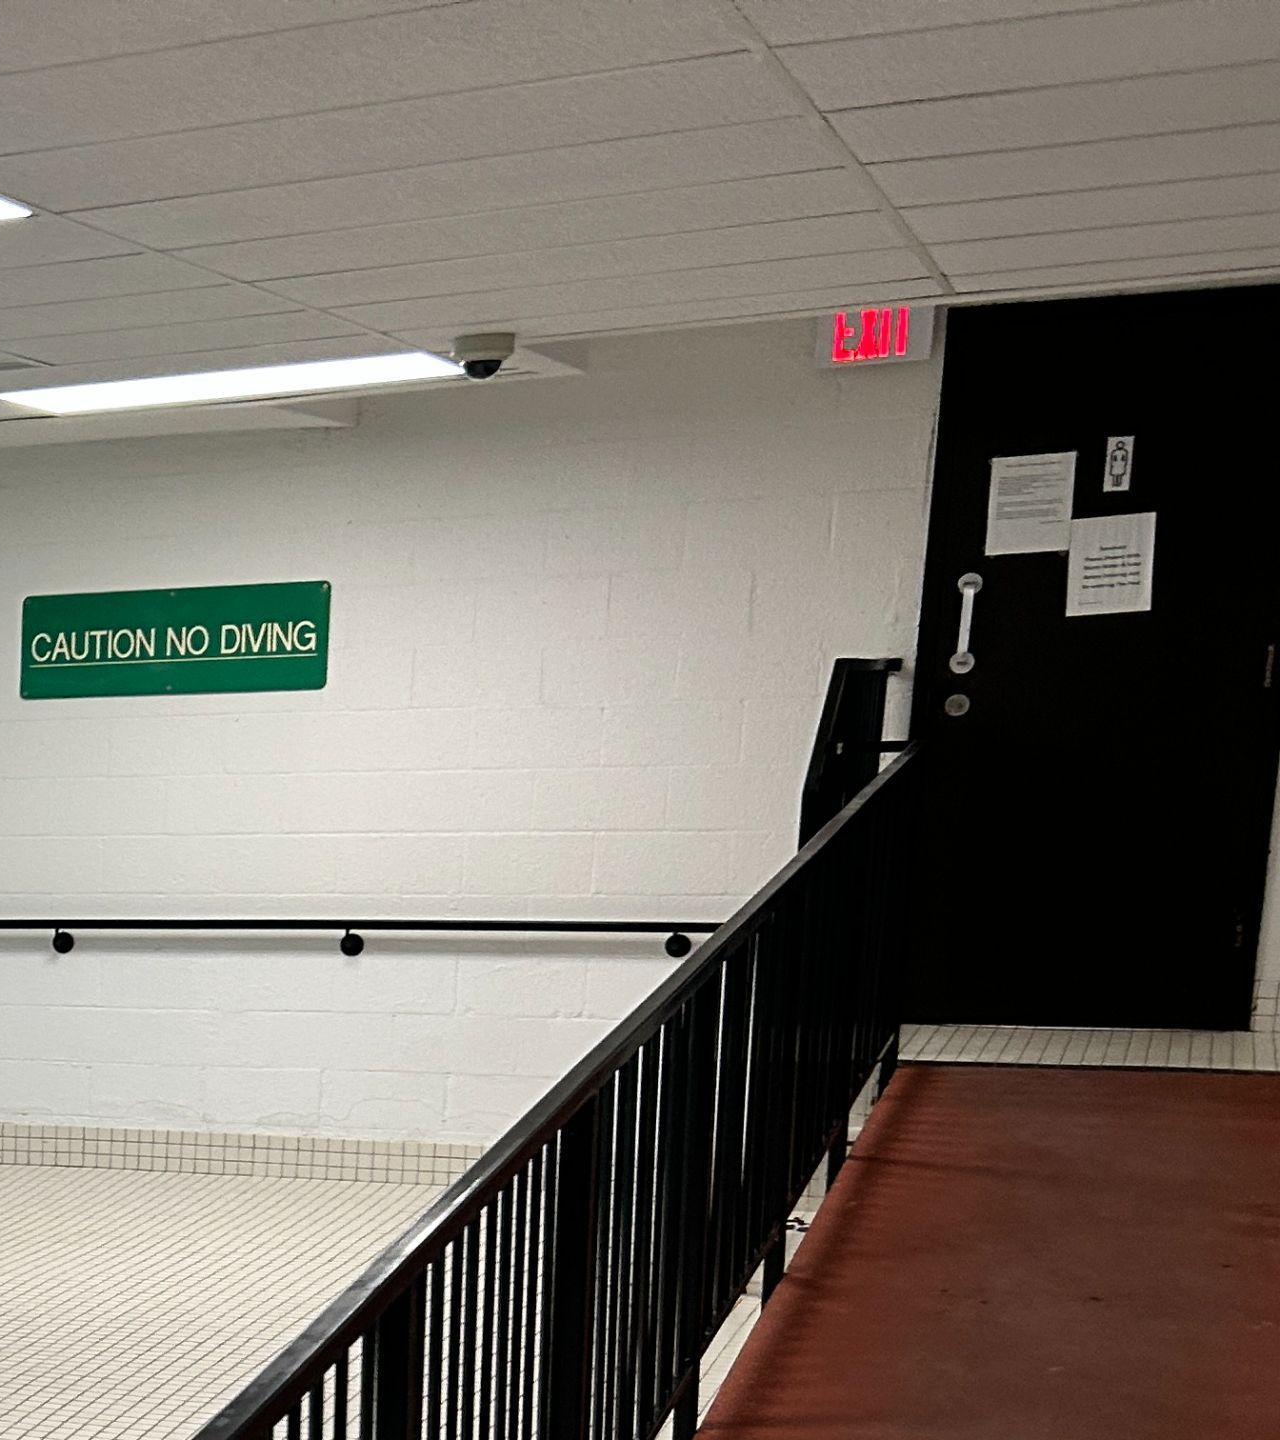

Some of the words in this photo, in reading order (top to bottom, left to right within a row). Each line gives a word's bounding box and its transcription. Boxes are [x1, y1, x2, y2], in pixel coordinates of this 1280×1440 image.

[831, 305, 910, 362] EXIT
[31, 628, 156, 662] CAUTION
[166, 626, 209, 656] NO
[220, 621, 317, 654] DIVING
